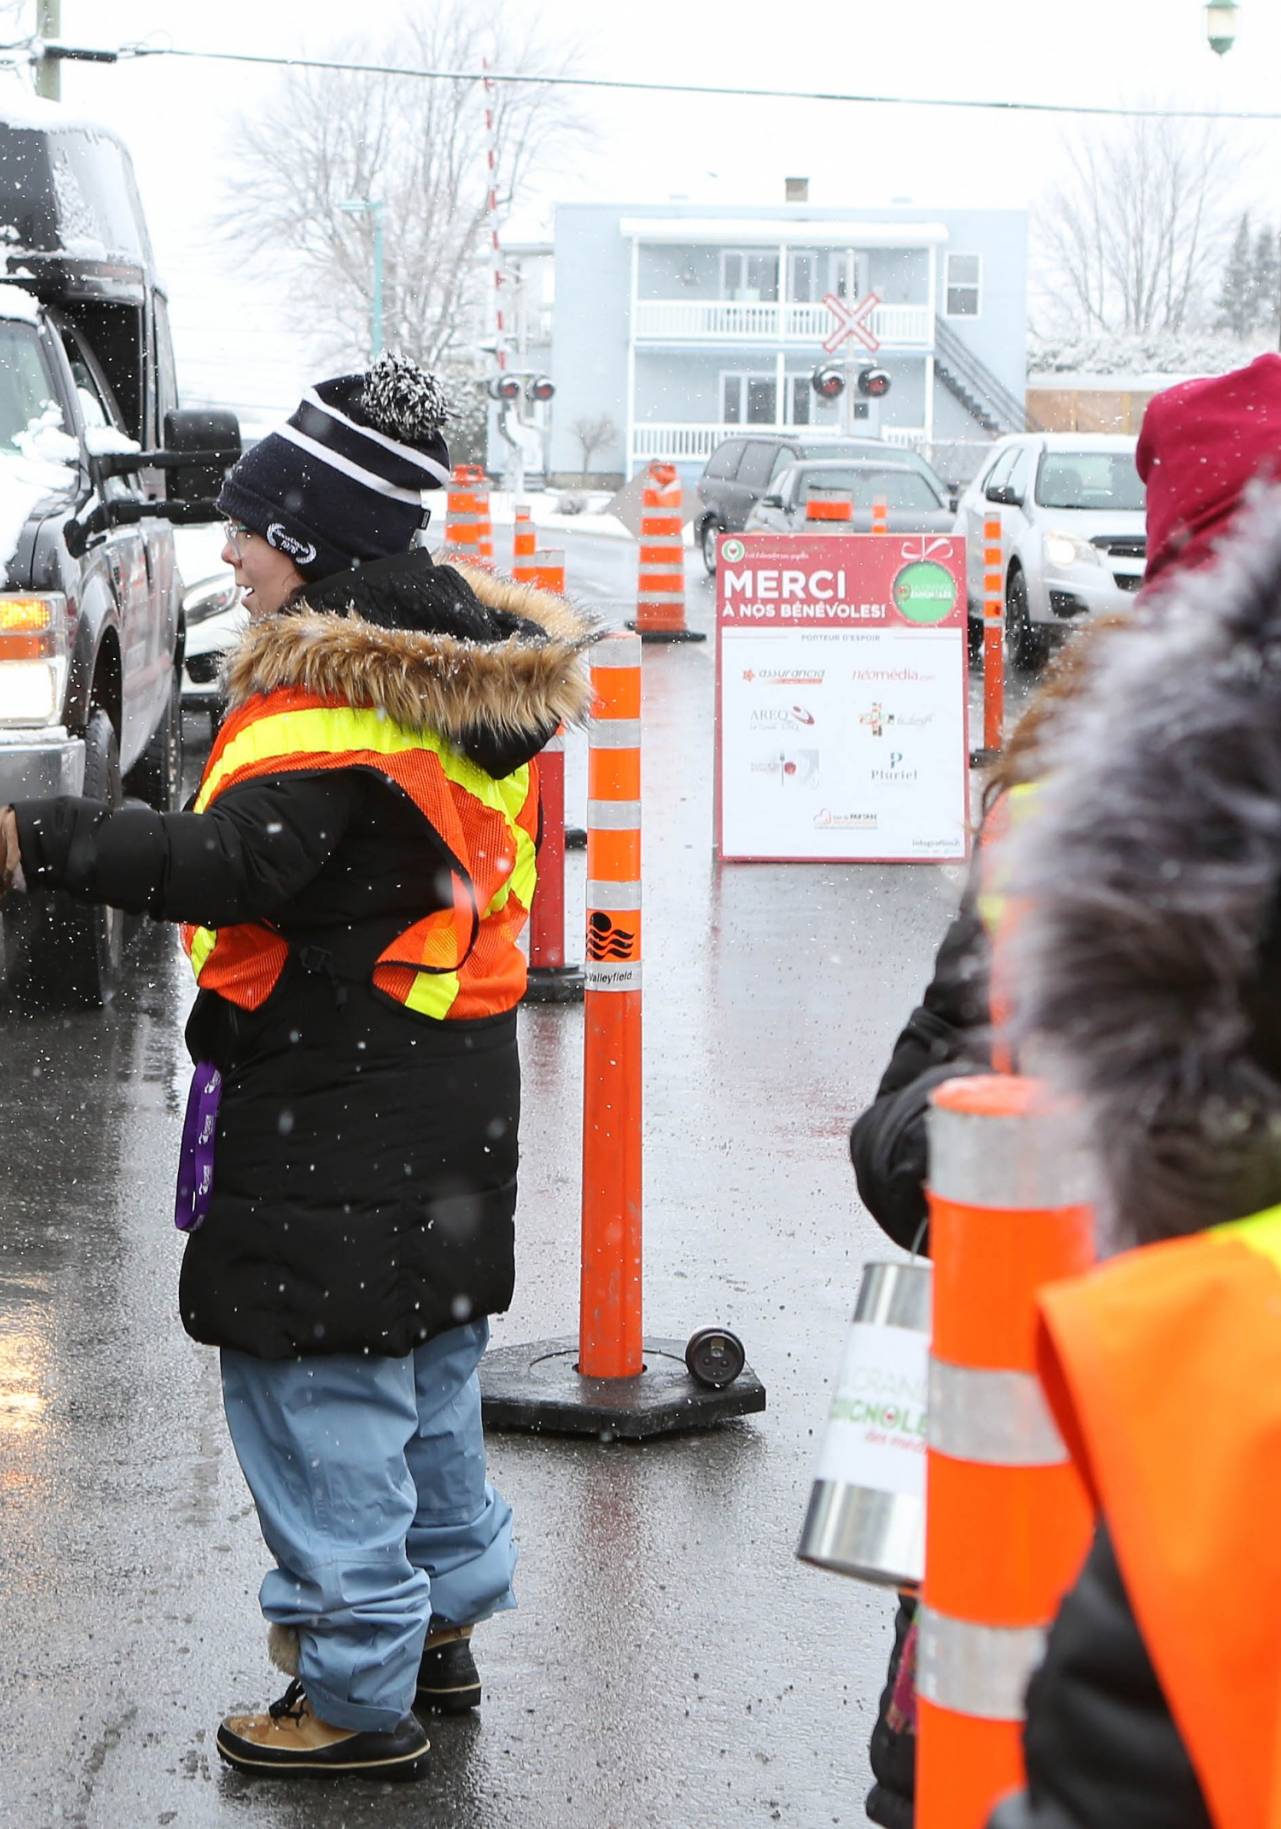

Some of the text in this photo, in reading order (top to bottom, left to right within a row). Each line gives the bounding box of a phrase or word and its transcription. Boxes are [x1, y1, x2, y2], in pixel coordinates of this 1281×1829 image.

[724, 569, 846, 599] MERCI
[722, 600, 886, 619] À NOS BÉNÉVOLES!
[588, 970, 633, 985] Valleyfield
